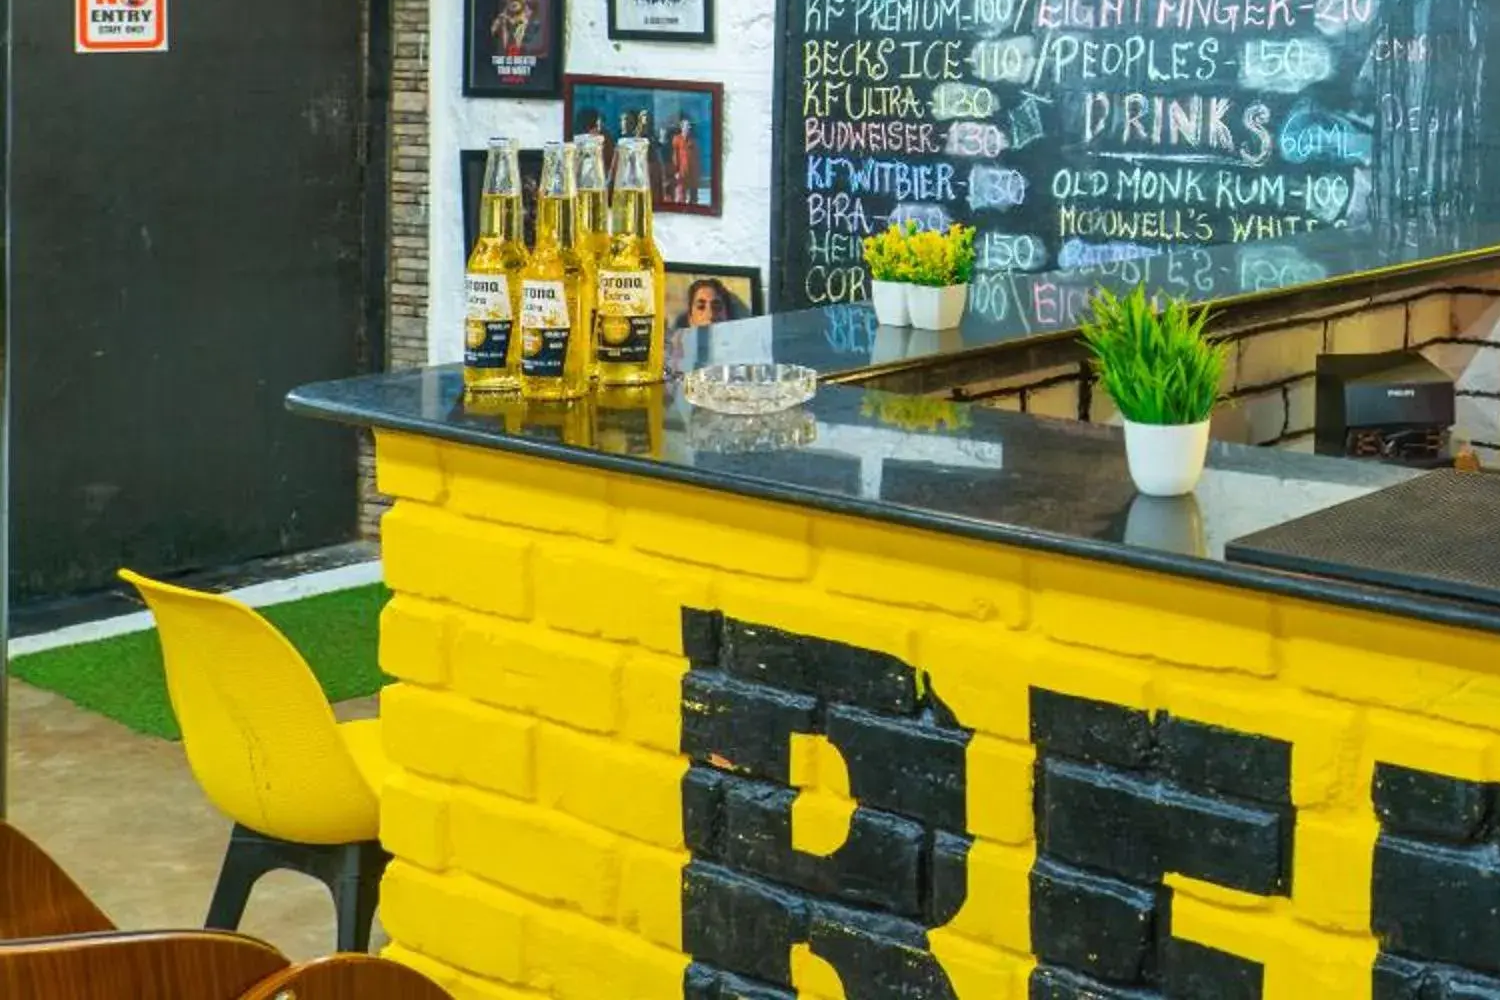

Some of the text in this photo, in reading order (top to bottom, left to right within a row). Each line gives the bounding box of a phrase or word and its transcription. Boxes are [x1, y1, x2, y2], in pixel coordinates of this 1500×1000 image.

[92, 9, 151, 23] ENTRY
[803, 38, 896, 81] BECKS
[1084, 91, 1272, 167] DRINKS
[1052, 169, 1109, 199] OLD
[1117, 167, 1206, 201] MONK
